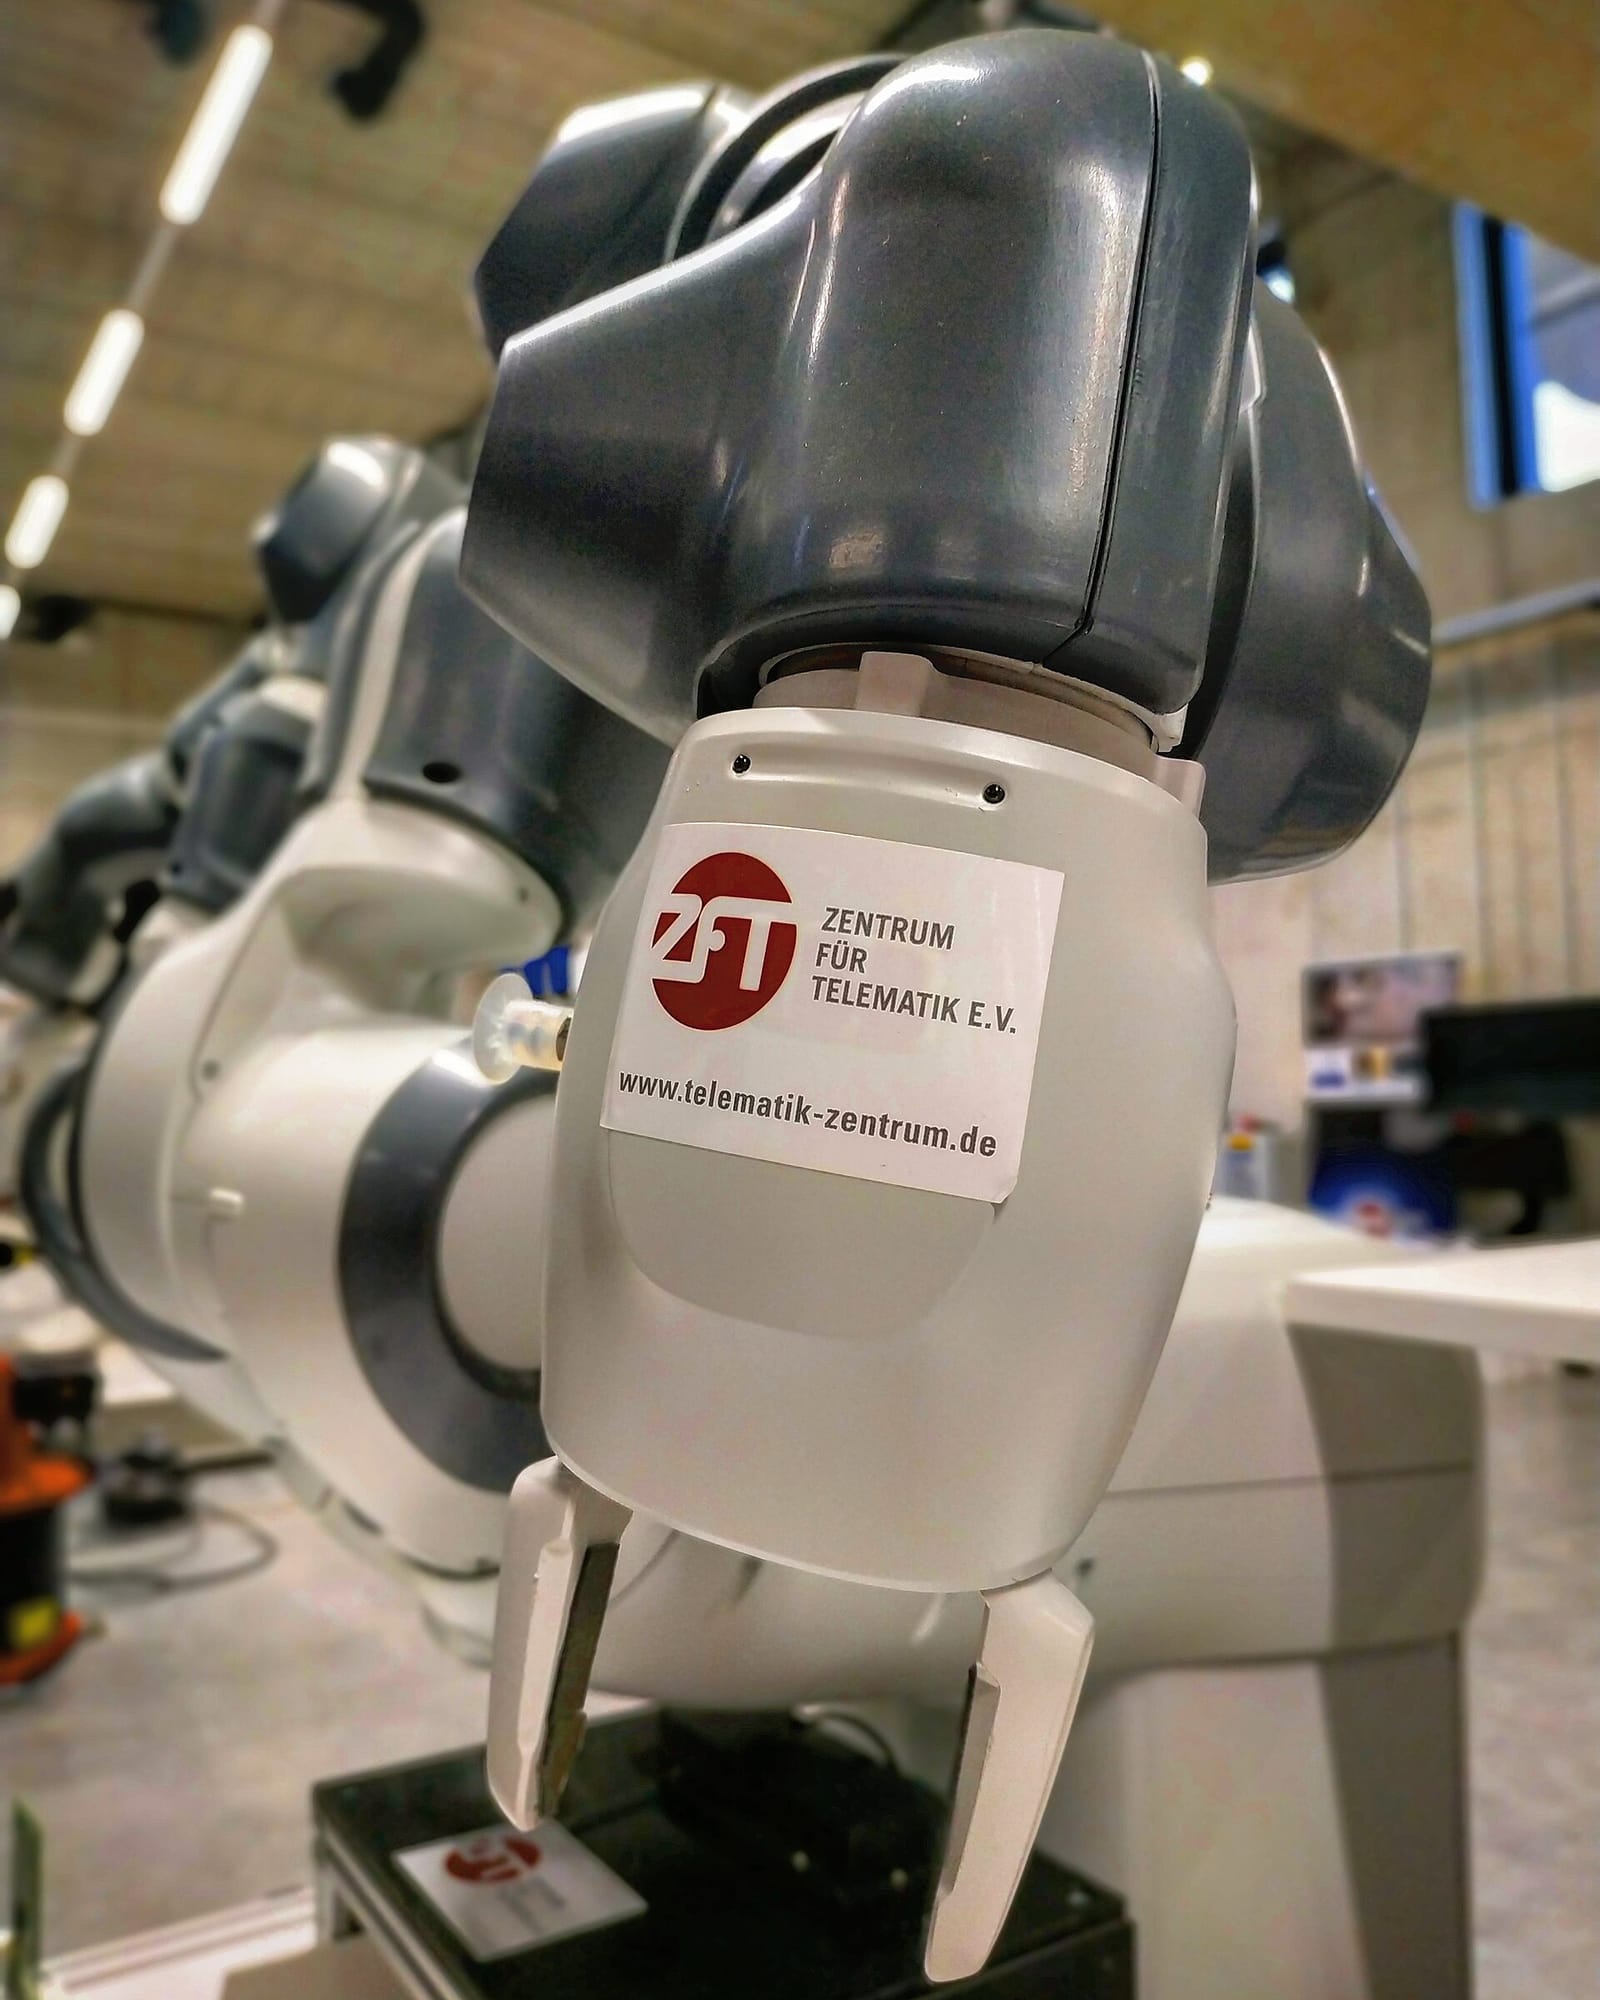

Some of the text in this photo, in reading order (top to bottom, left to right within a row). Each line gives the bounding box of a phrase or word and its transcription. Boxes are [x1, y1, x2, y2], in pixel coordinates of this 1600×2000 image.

[820, 907, 955, 951] ZENTRUM
[816, 941, 867, 974] FÜR
[812, 975, 1016, 1034] TELEMATIK E.V.
[619, 1071, 997, 1157] www.telematik-zentrum.de
